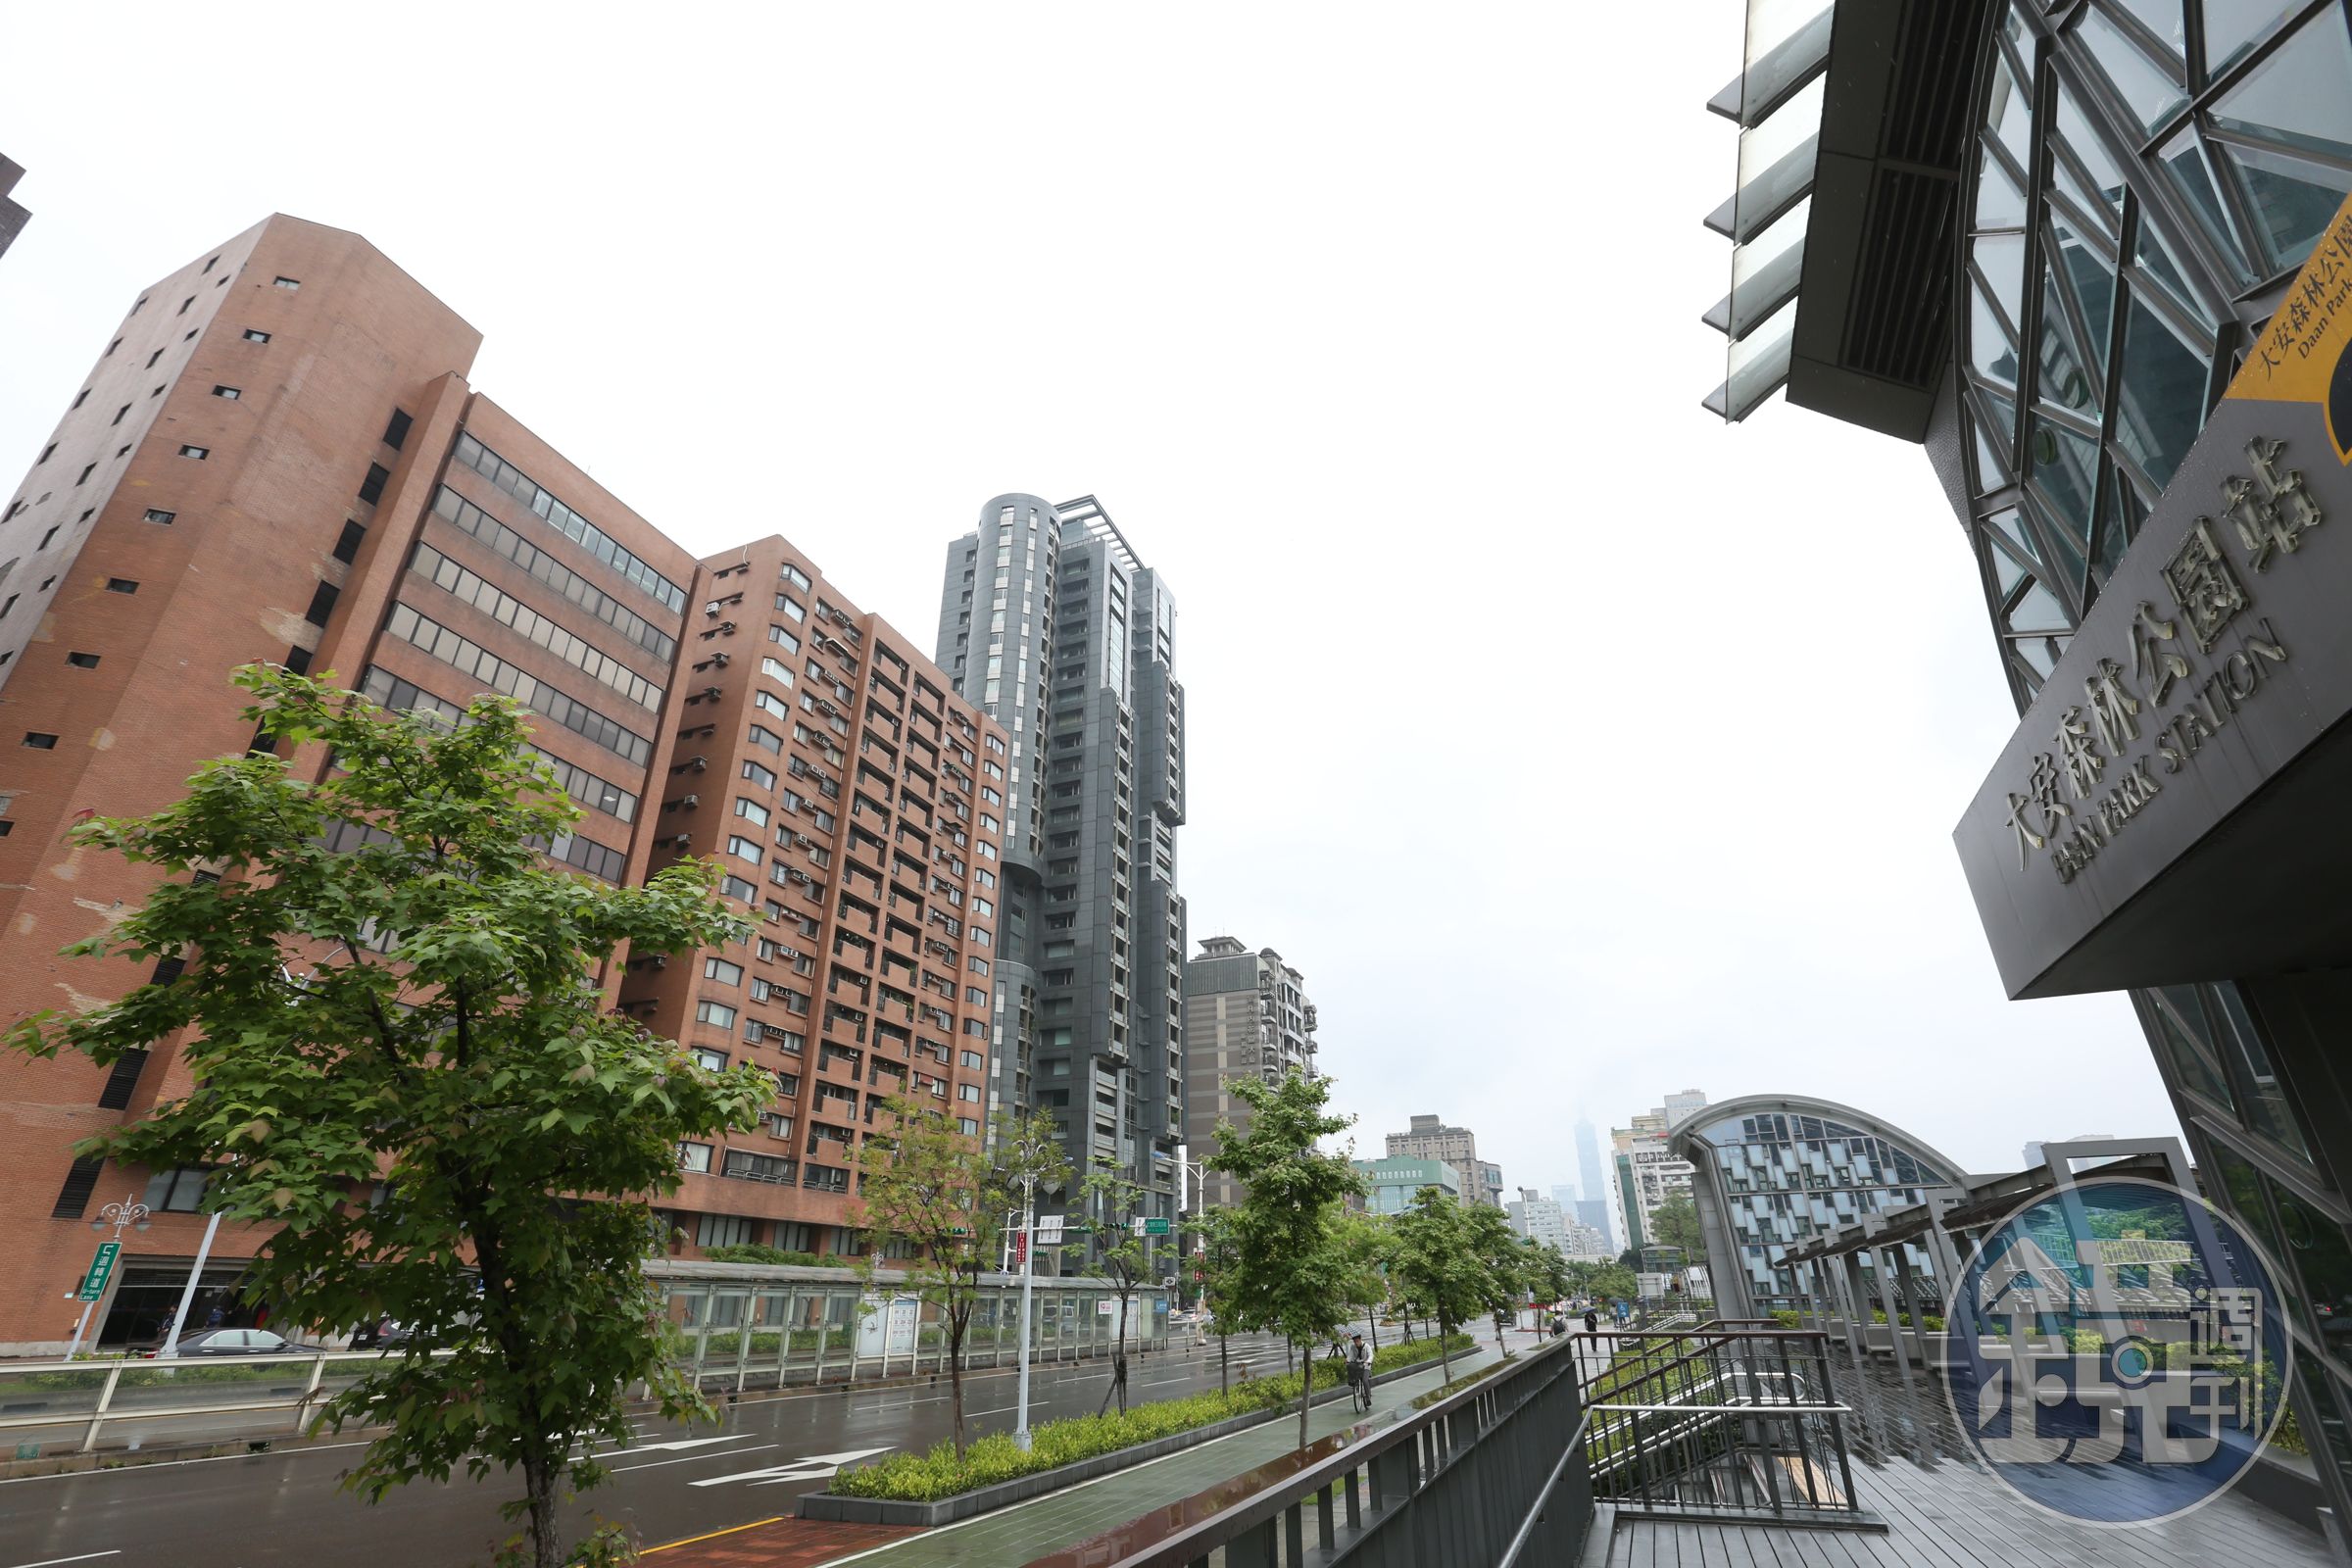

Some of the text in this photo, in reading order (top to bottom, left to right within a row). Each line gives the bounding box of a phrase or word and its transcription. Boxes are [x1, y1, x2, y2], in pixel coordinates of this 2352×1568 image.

[2297, 278, 2352, 359] Daan Park
[2004, 436, 2322, 871] 大安森林公園站
[2096, 755, 2161, 837] PARK
[2156, 617, 2286, 774] STATION
